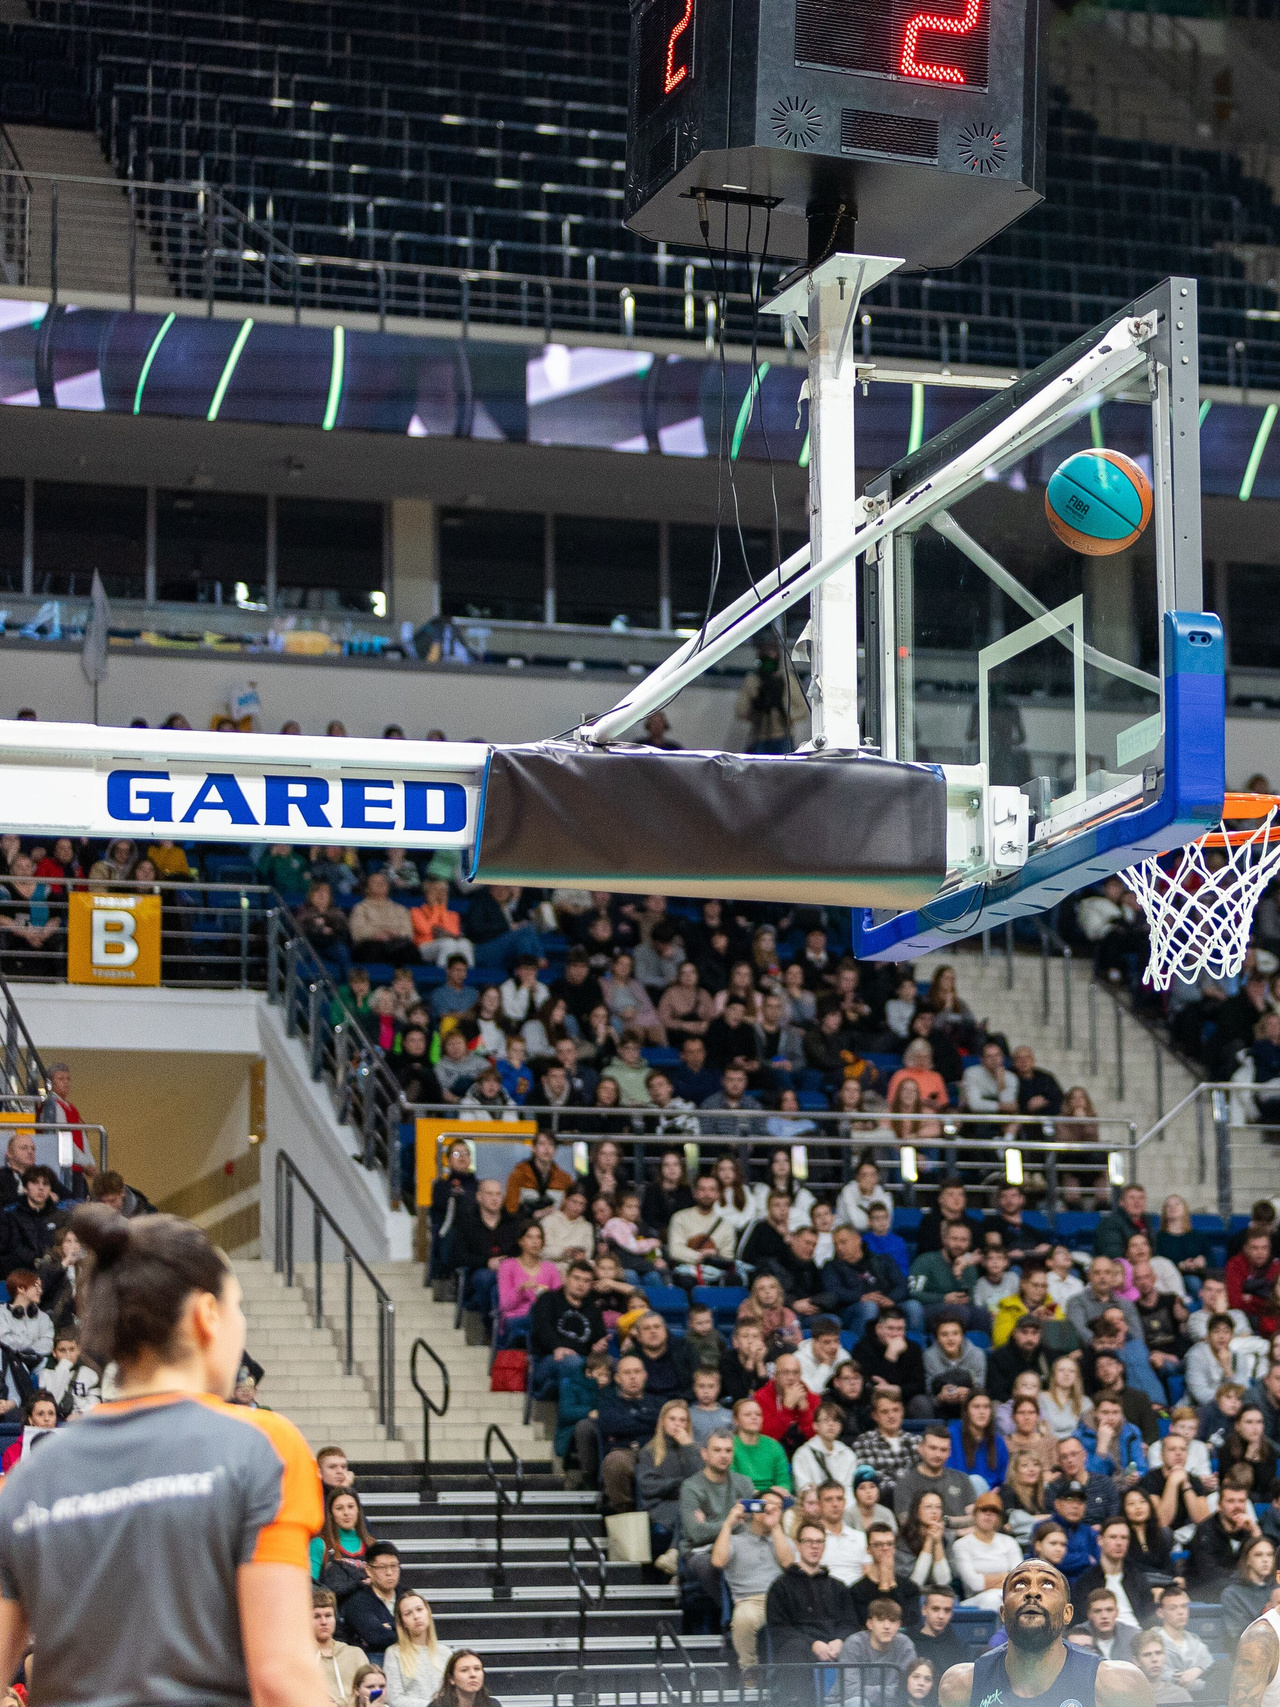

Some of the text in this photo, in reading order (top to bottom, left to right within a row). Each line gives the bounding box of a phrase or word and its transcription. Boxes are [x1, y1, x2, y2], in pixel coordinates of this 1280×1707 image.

[900, 0, 979, 83] 2
[1068, 494, 1090, 515] FIBA
[106, 769, 468, 833] GARED
[91, 908, 139, 967] B
